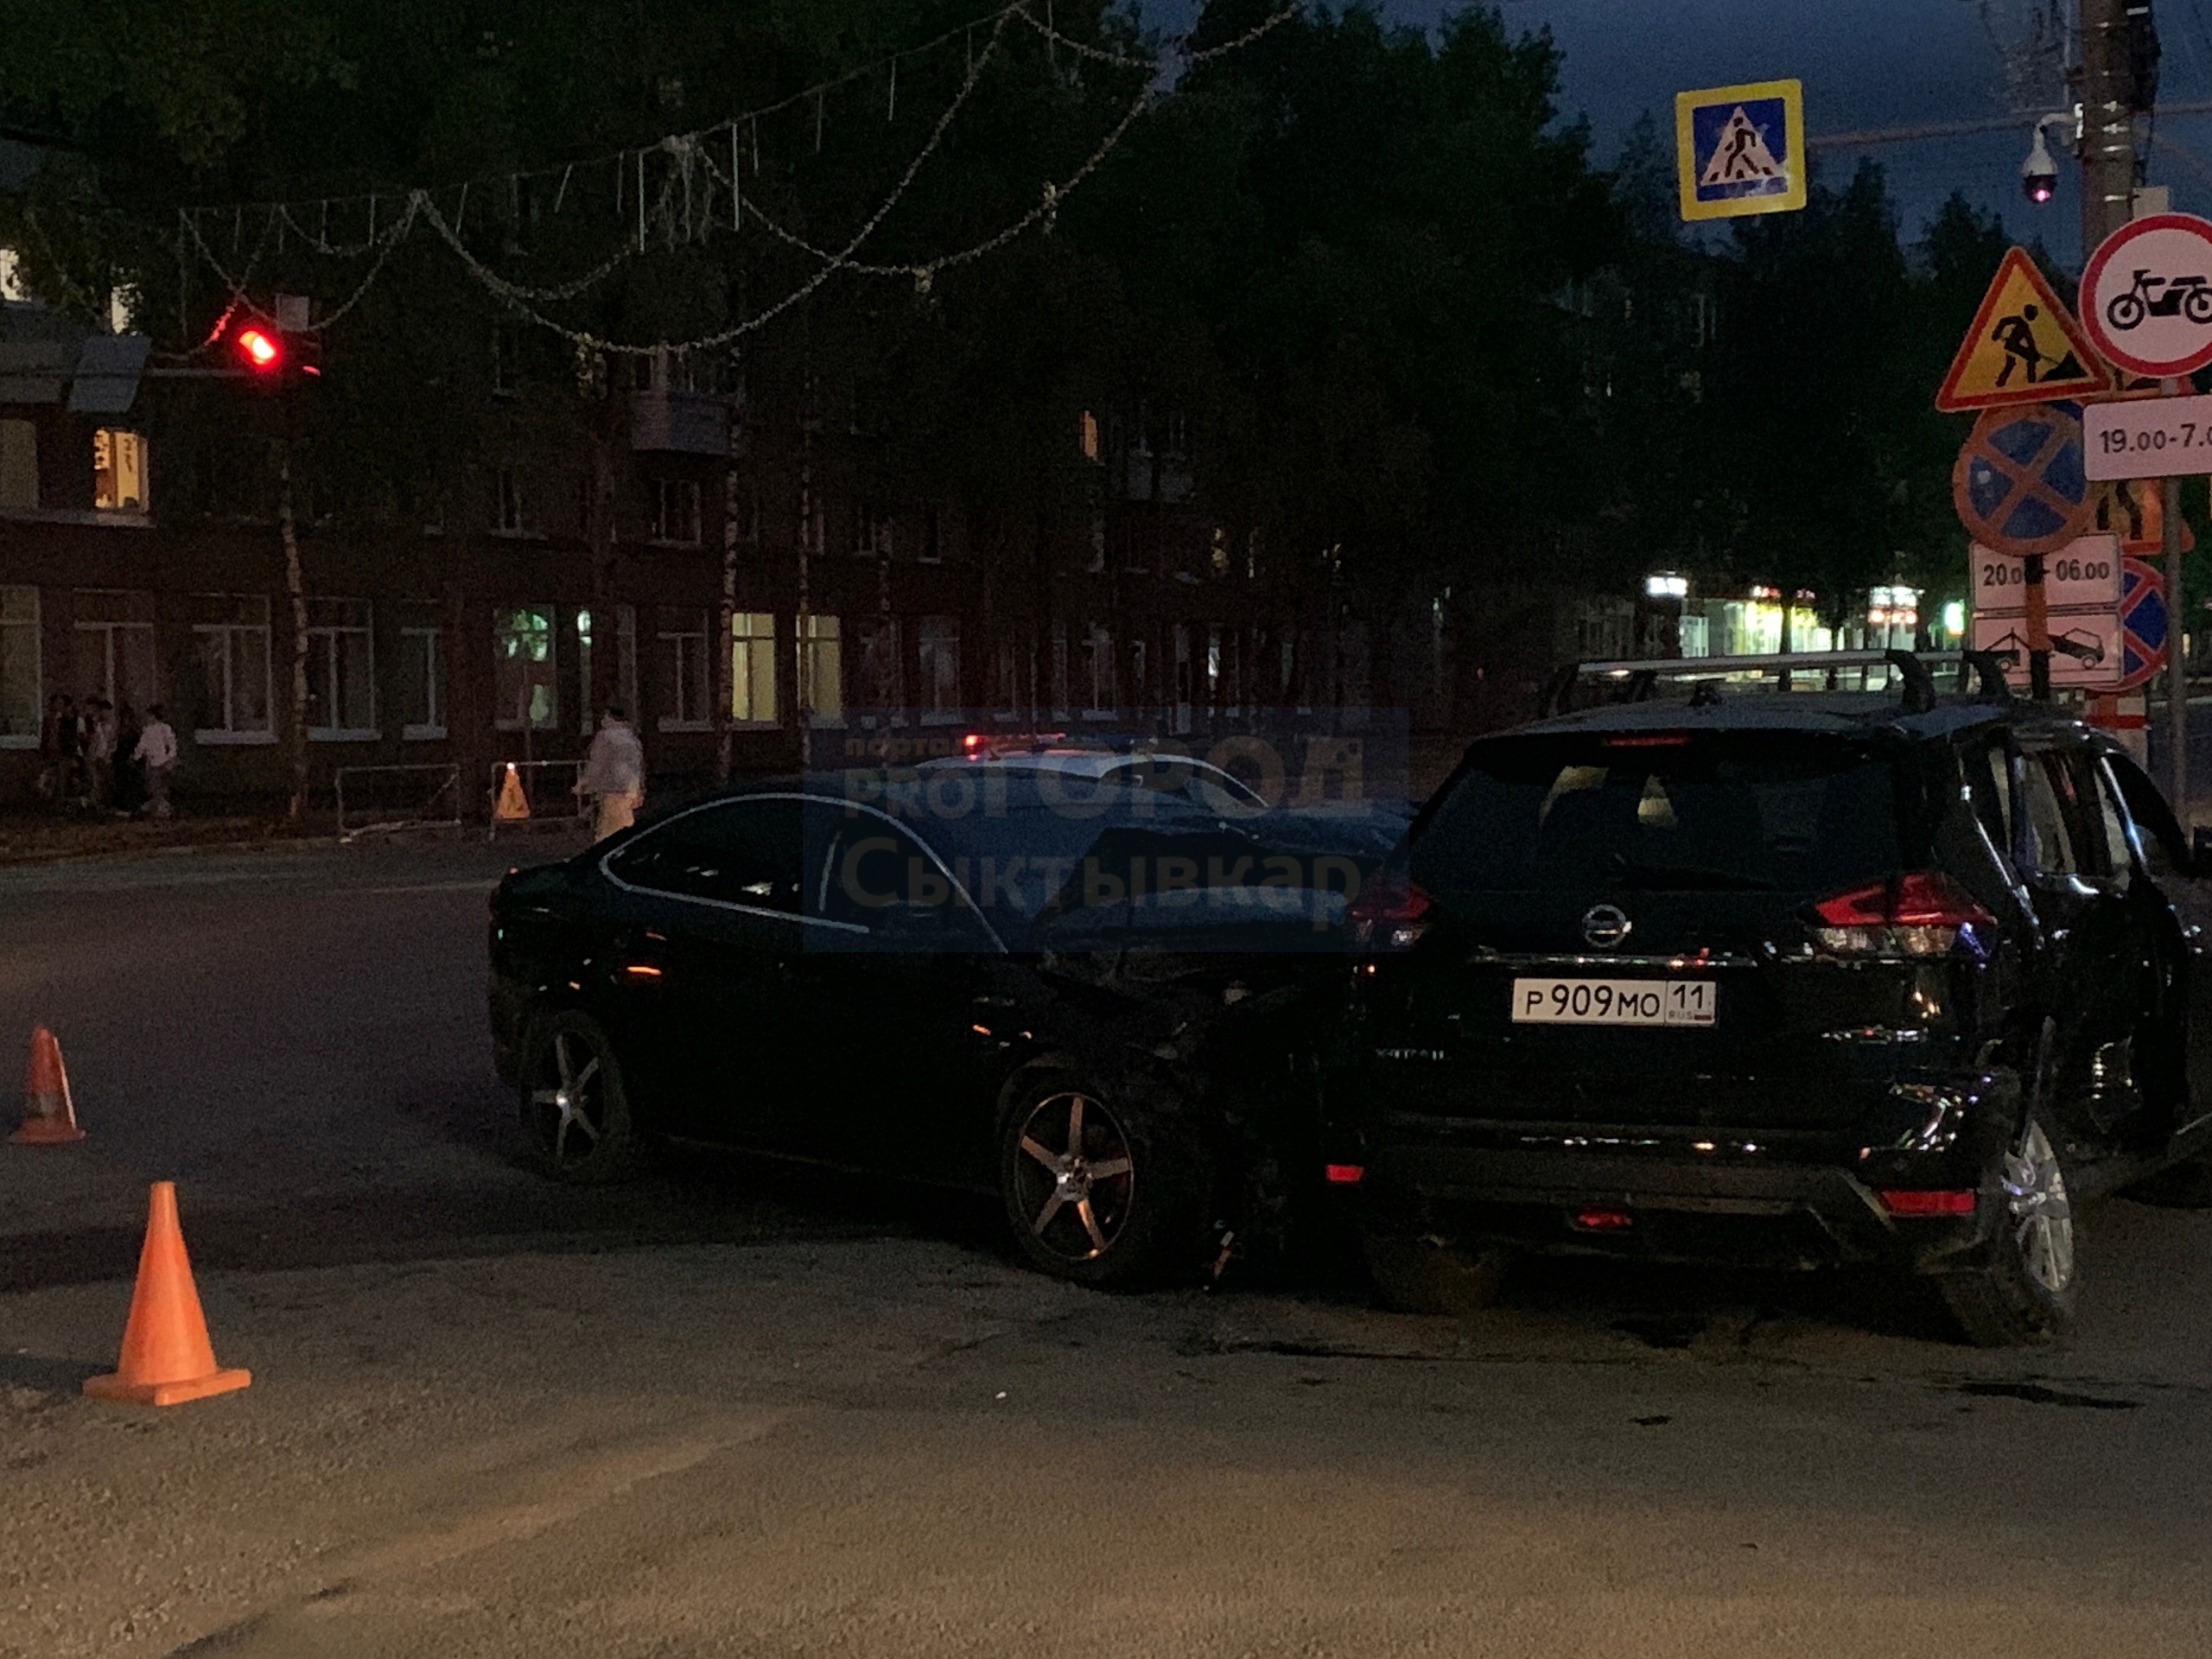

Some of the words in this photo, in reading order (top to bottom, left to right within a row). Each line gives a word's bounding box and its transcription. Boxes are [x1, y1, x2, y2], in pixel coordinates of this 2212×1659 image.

[1983, 563, 2024, 586] 20.0
[1673, 984, 1704, 1009] 11
[1669, 1010, 1694, 1020] RUS
